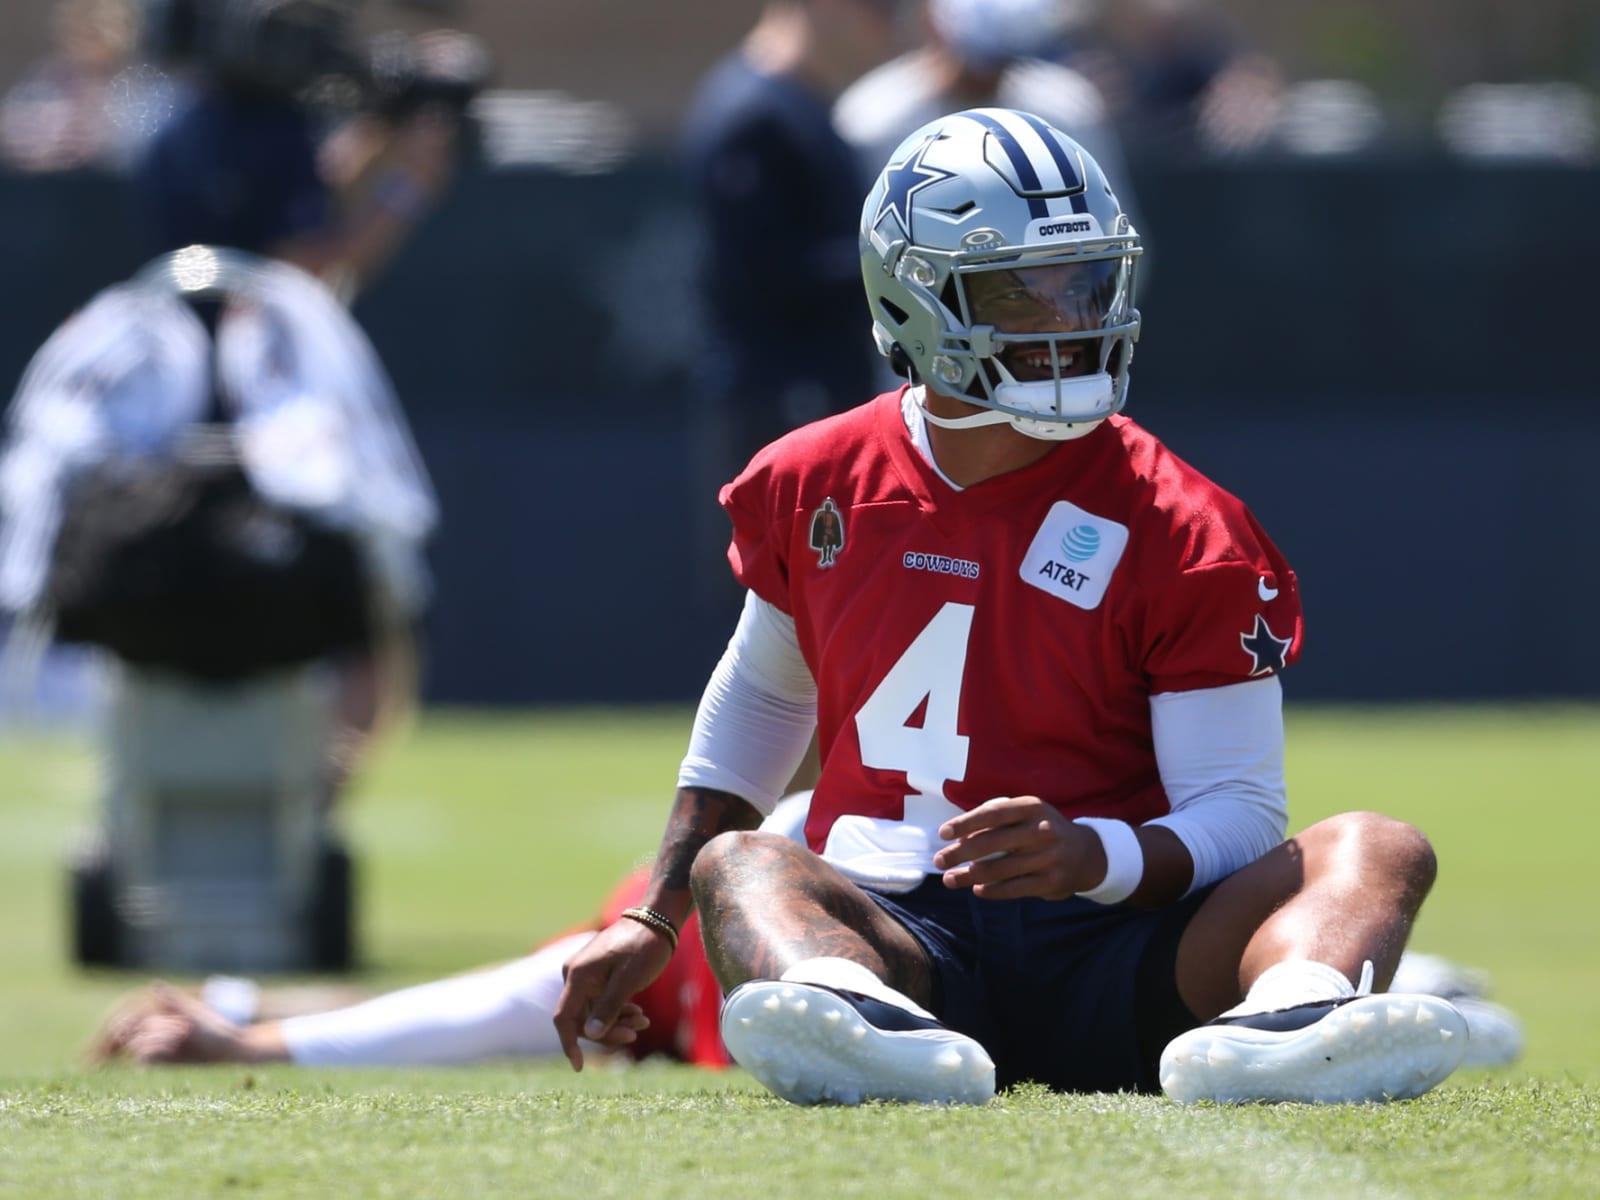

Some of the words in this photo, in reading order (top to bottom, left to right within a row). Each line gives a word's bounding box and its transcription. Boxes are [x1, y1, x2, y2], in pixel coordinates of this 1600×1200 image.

[1039, 221, 1090, 236] COWBOYS
[903, 551, 979, 579] COWBOYS
[1039, 560, 1090, 591] AT&T
[854, 601, 975, 822] 4
